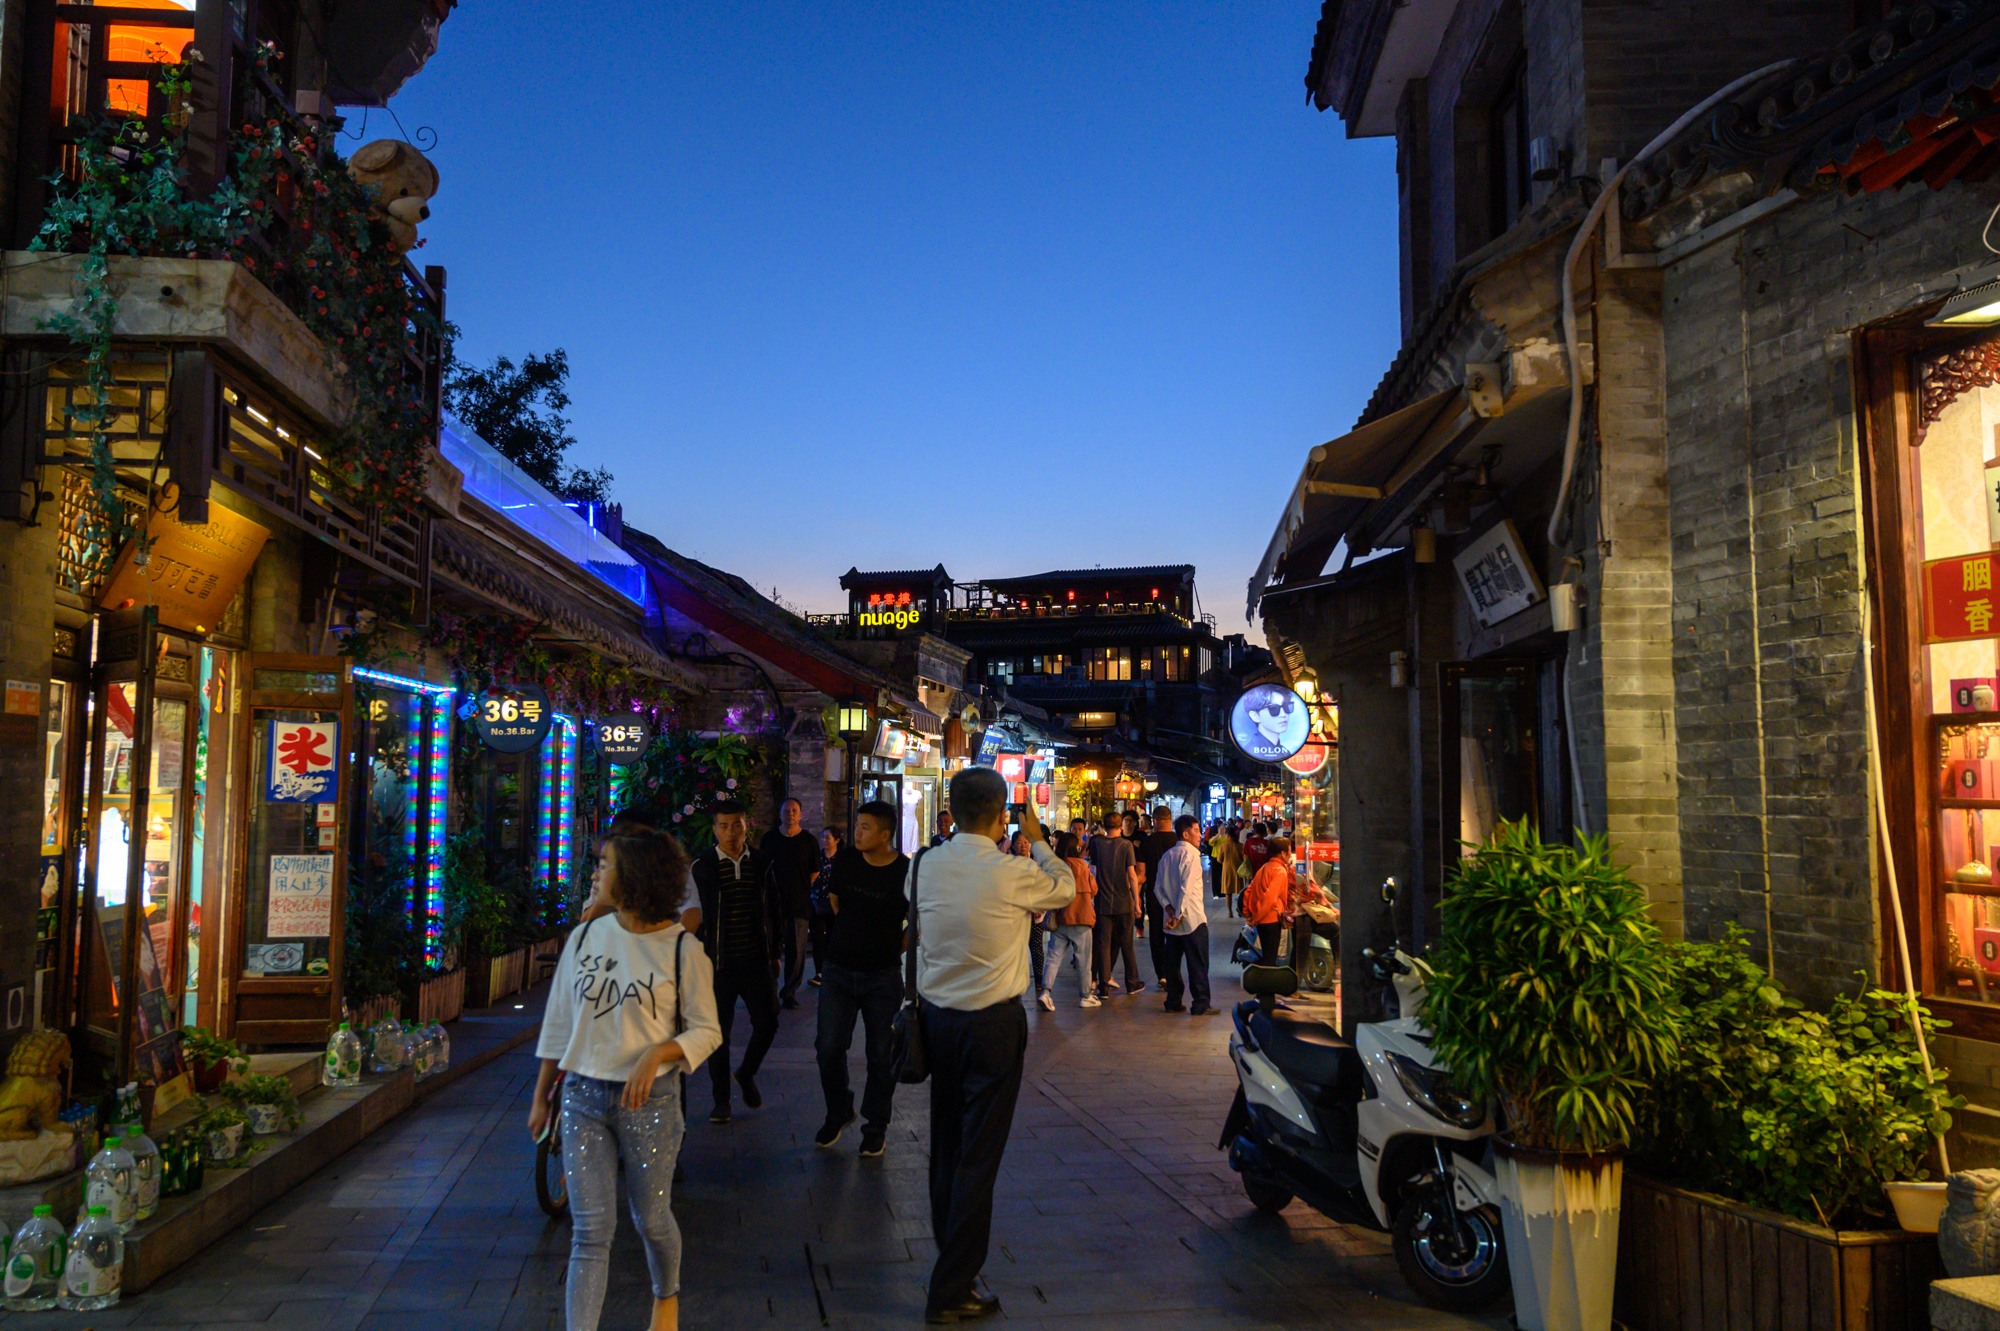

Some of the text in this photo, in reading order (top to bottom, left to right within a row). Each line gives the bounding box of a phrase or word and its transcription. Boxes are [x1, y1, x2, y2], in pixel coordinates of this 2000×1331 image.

[860, 610, 920, 630] nuage
[485, 699, 542, 723] 36号
[490, 727, 536, 736] No.36.Bar
[600, 725, 643, 743] 36号
[1253, 746, 1288, 754] BOLON
[272, 856, 332, 876] 购物请进
[275, 874, 329, 896] 闲人止步
